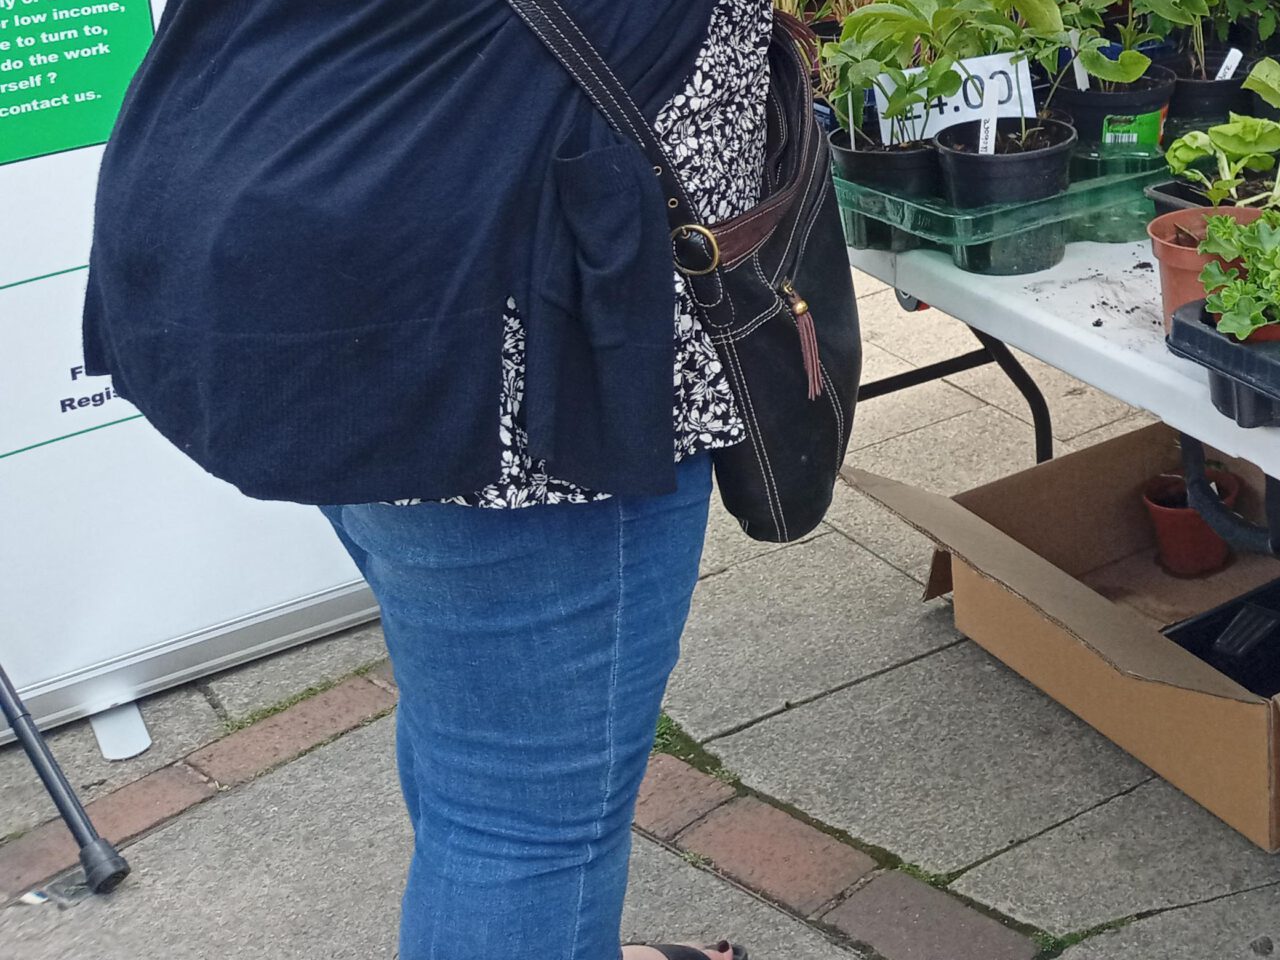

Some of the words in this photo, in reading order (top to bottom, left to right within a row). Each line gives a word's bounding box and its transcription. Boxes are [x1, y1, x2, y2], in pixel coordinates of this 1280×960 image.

[14, 13, 47, 26] low
[52, 1, 126, 20] income,
[16, 36, 35, 48] to
[40, 29, 78, 43] turn
[83, 25, 108, 36] to,
[1, 58, 24, 71] do
[29, 53, 59, 66] the
[64, 42, 111, 60] work
[47, 72, 57, 84] ?
[0, 93, 69, 117] contact
[74, 91, 102, 102] us.
